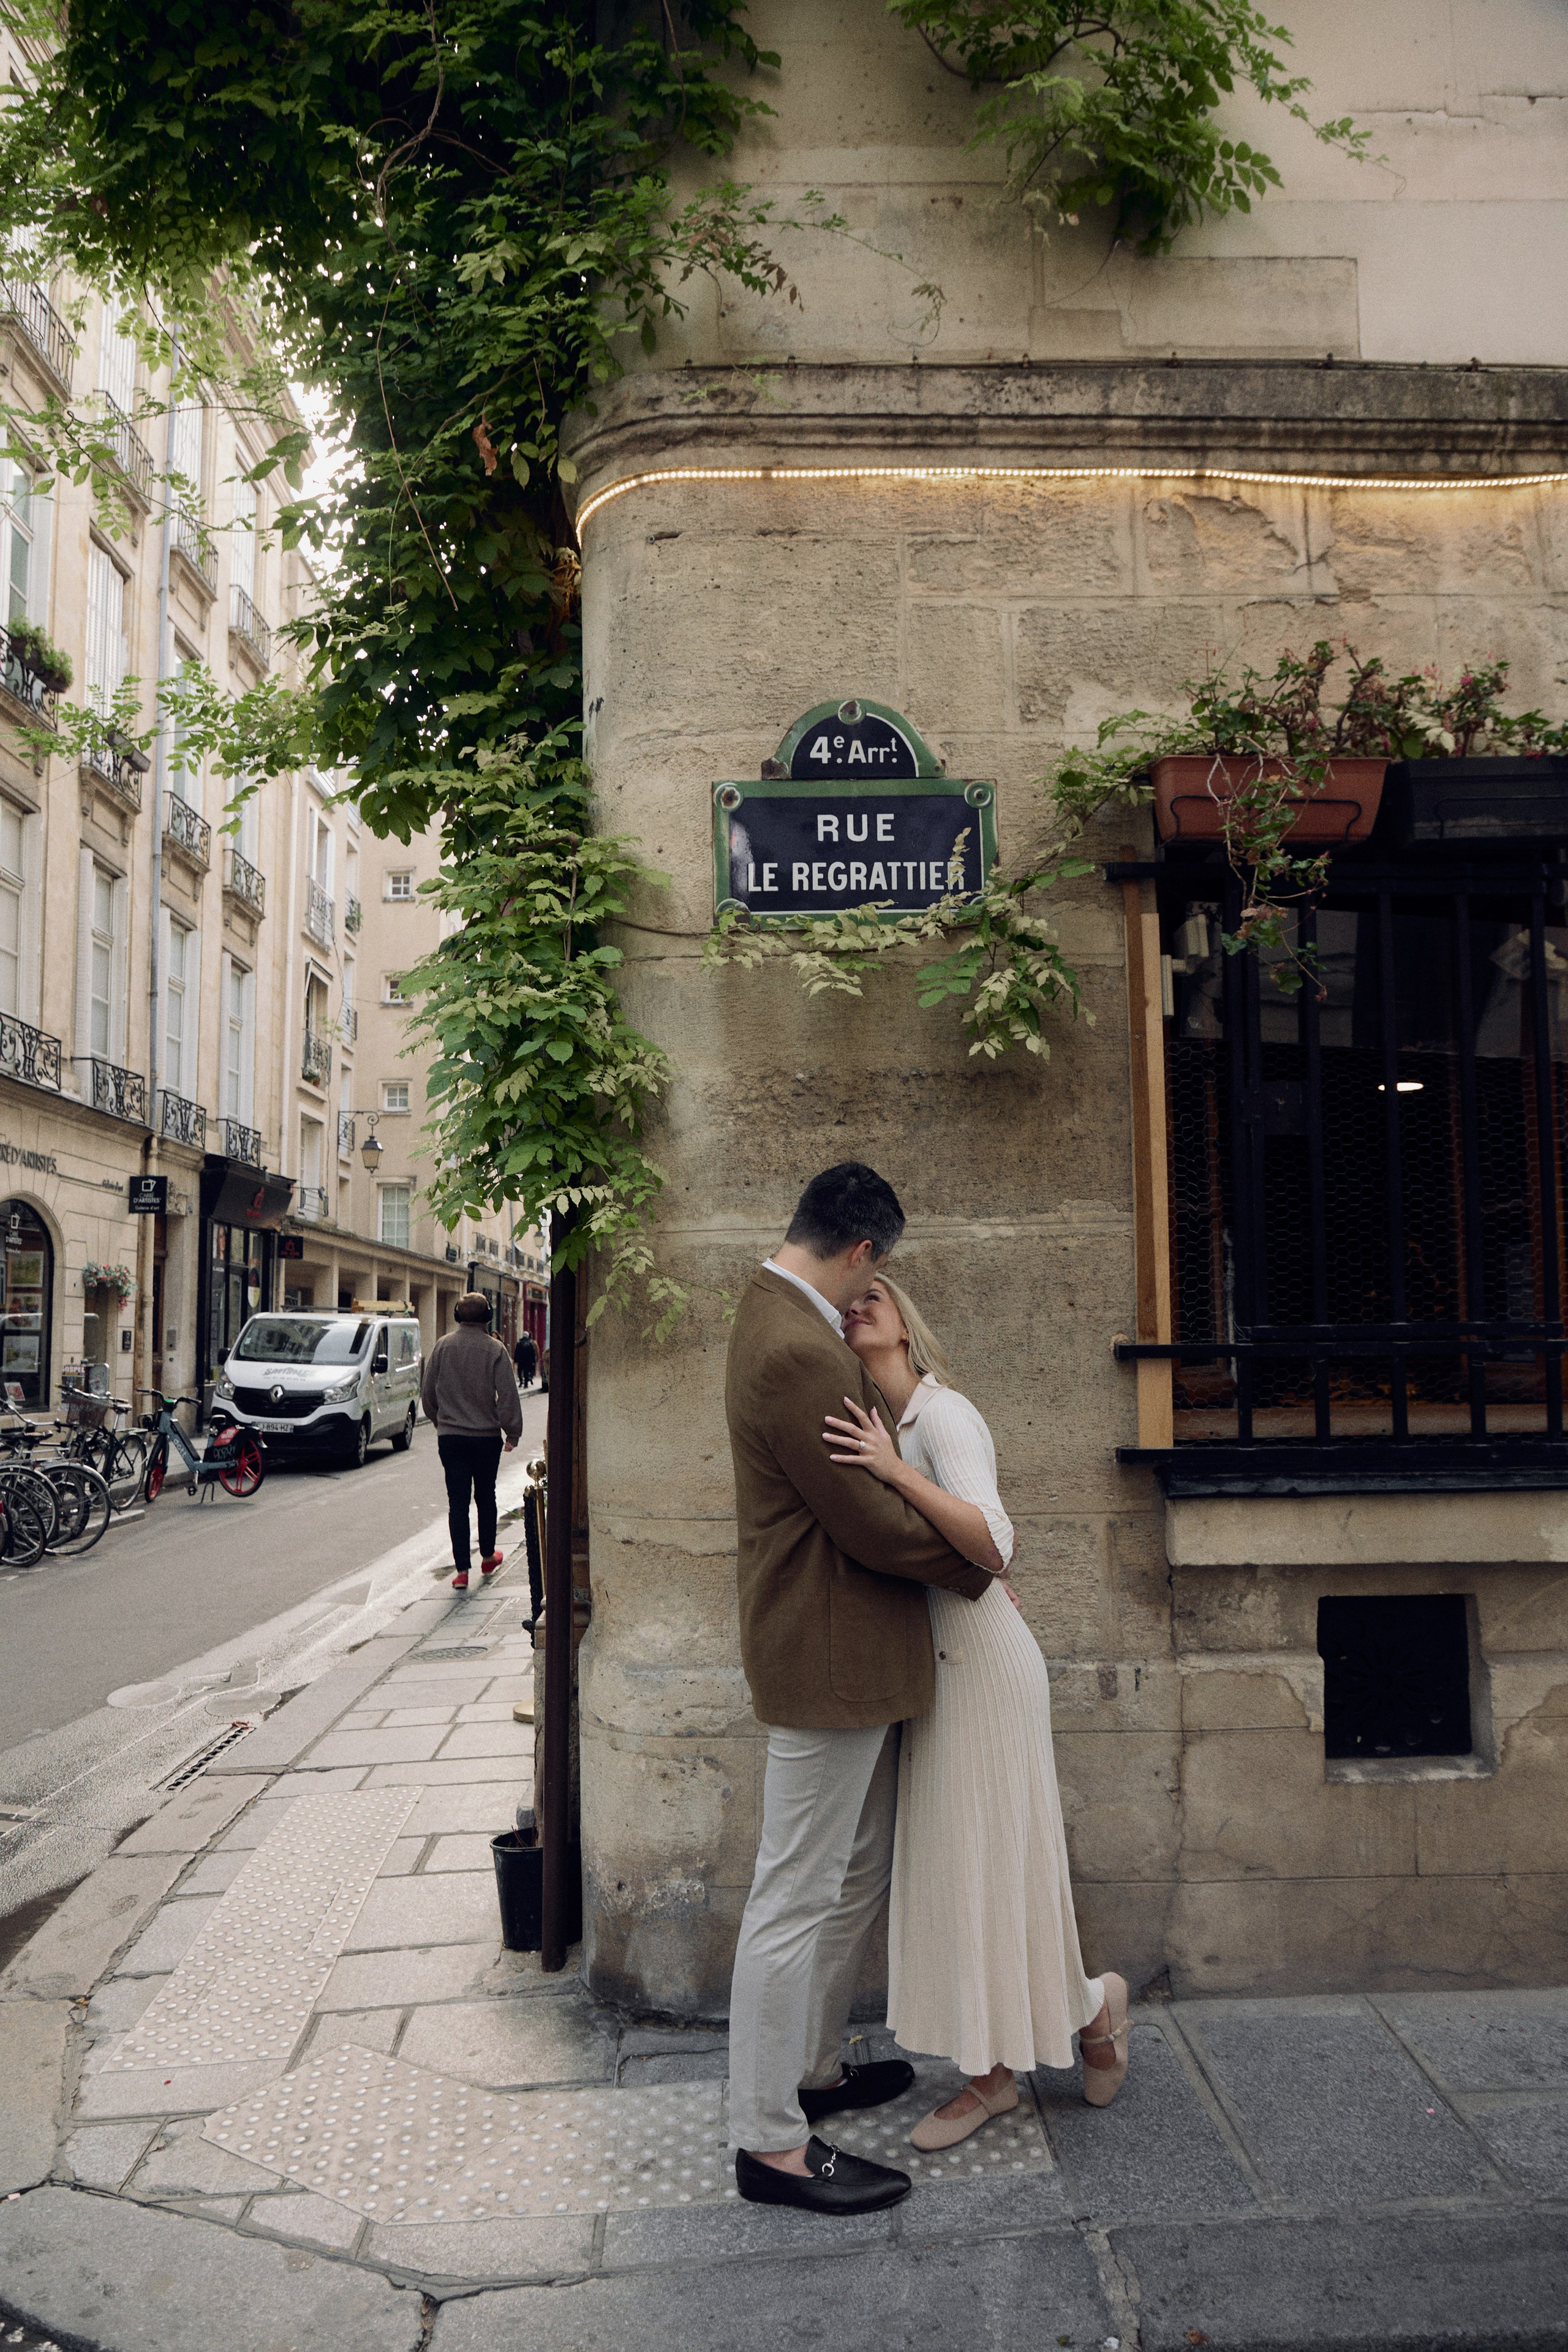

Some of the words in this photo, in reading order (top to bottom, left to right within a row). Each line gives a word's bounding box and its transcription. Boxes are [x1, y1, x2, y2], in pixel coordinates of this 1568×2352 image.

[817, 813, 895, 842] RUE
[748, 862, 778, 892] LE
[792, 861, 965, 891] REGRATTIER
[11, 1146, 57, 1174] D'ARTISTES
